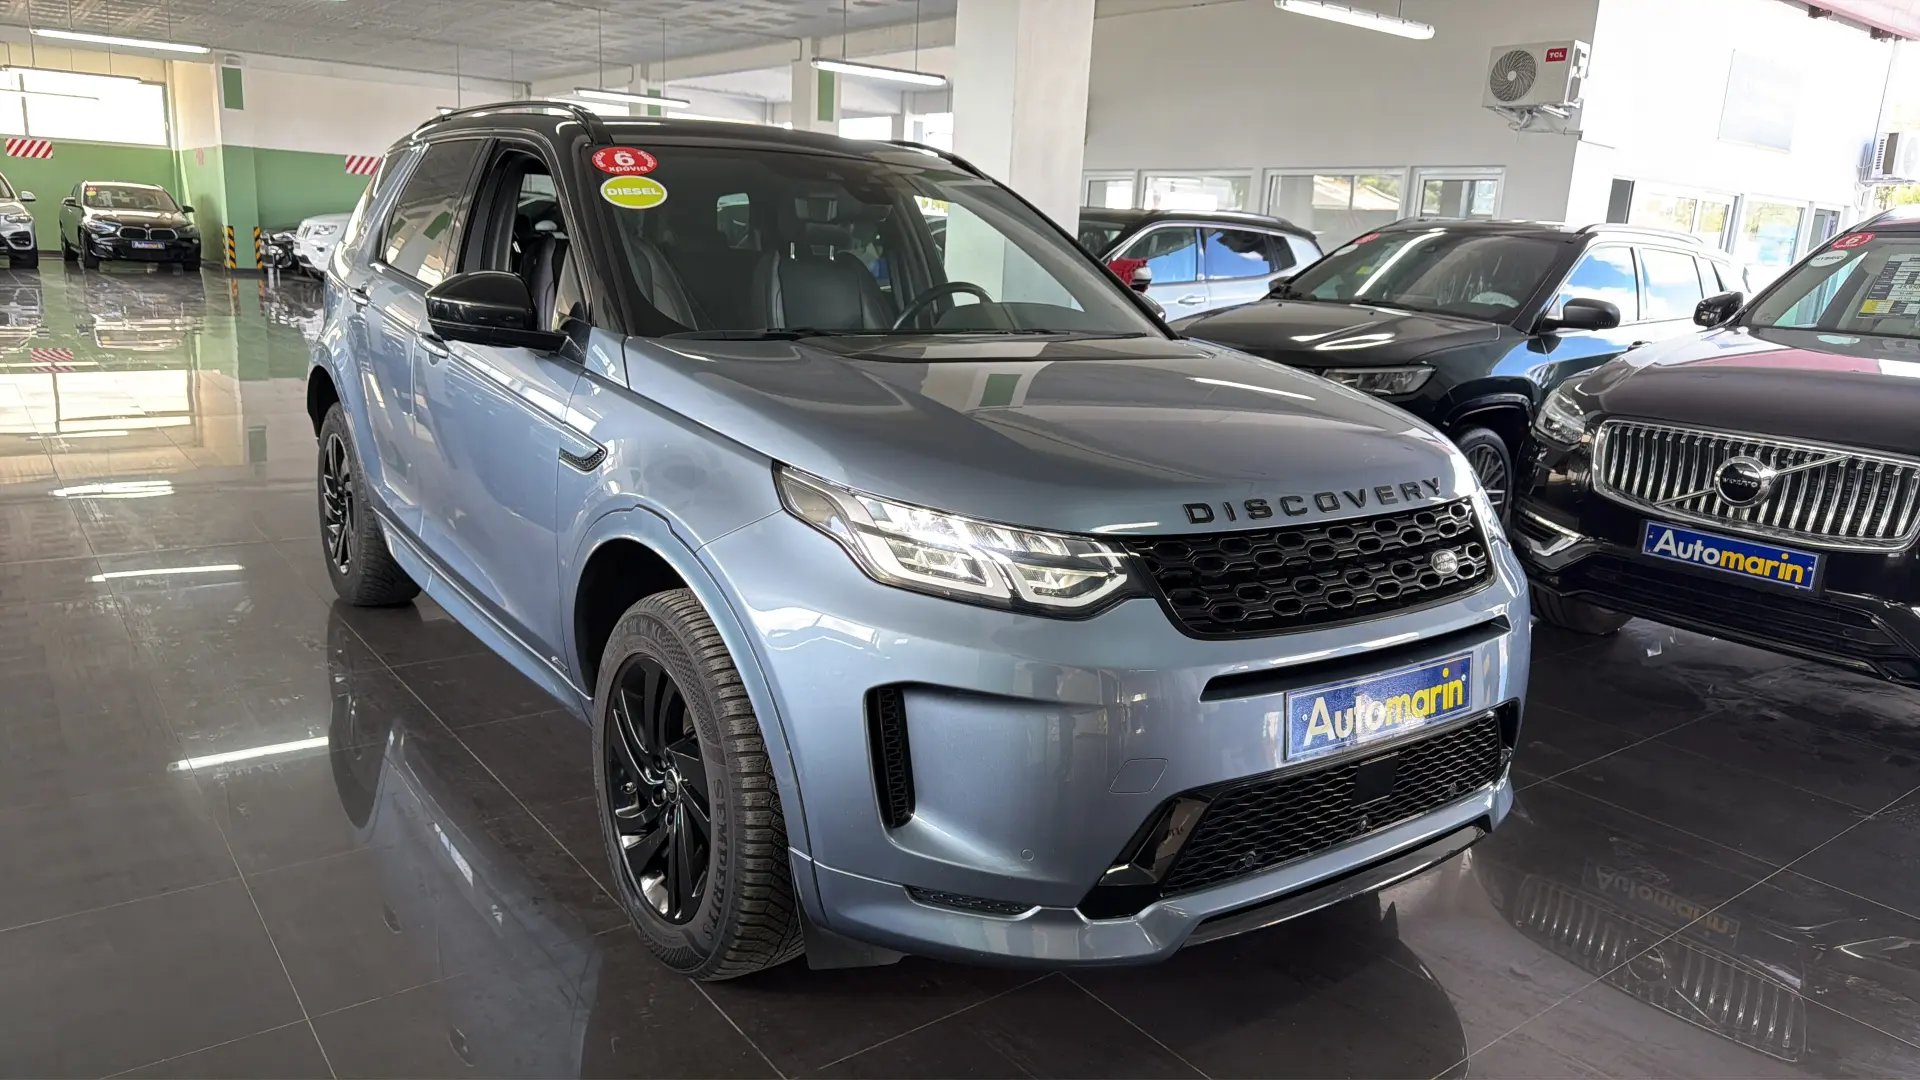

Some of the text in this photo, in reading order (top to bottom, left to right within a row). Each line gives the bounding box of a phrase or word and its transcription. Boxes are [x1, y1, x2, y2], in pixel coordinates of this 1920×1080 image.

[613, 152, 635, 166] 6
[606, 187, 660, 195] DIESEL
[1182, 476, 1442, 524] DISCOVERY
[1652, 529, 1804, 583] Automarin
[1303, 667, 1463, 747] Automarin
